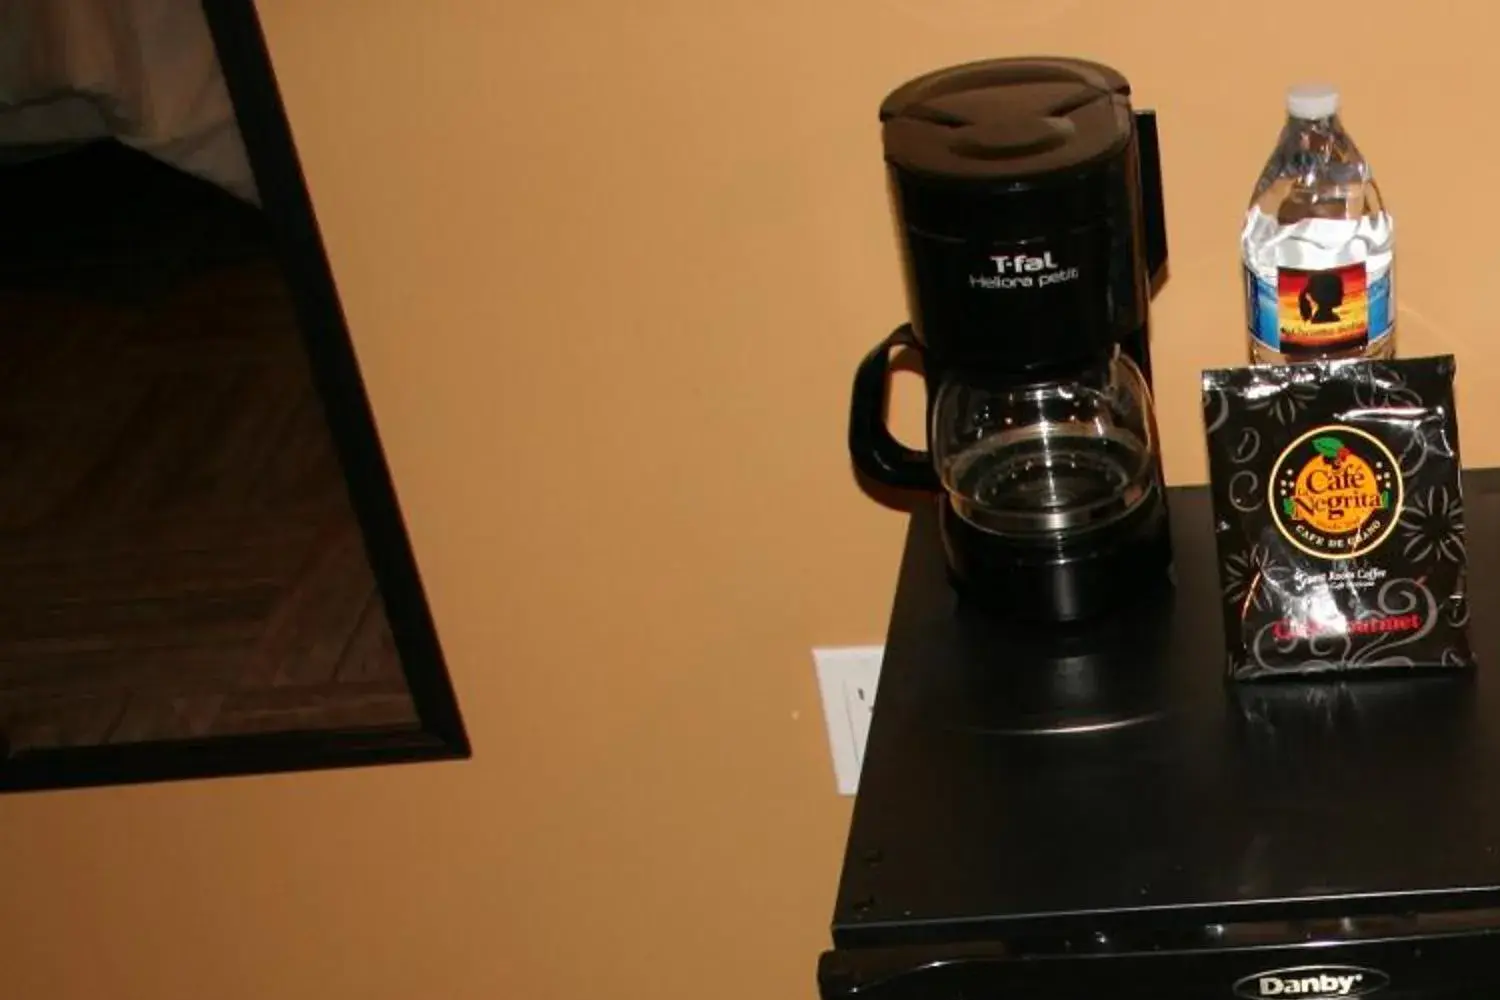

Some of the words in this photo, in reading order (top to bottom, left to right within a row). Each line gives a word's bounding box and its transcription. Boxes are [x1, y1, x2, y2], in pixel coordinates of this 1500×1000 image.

[991, 252, 1058, 273] T-fal
[1307, 465, 1364, 494] Café
[1293, 491, 1381, 520] Negrita
[1328, 539, 1345, 548] DE
[1260, 974, 1355, 995] Danby
